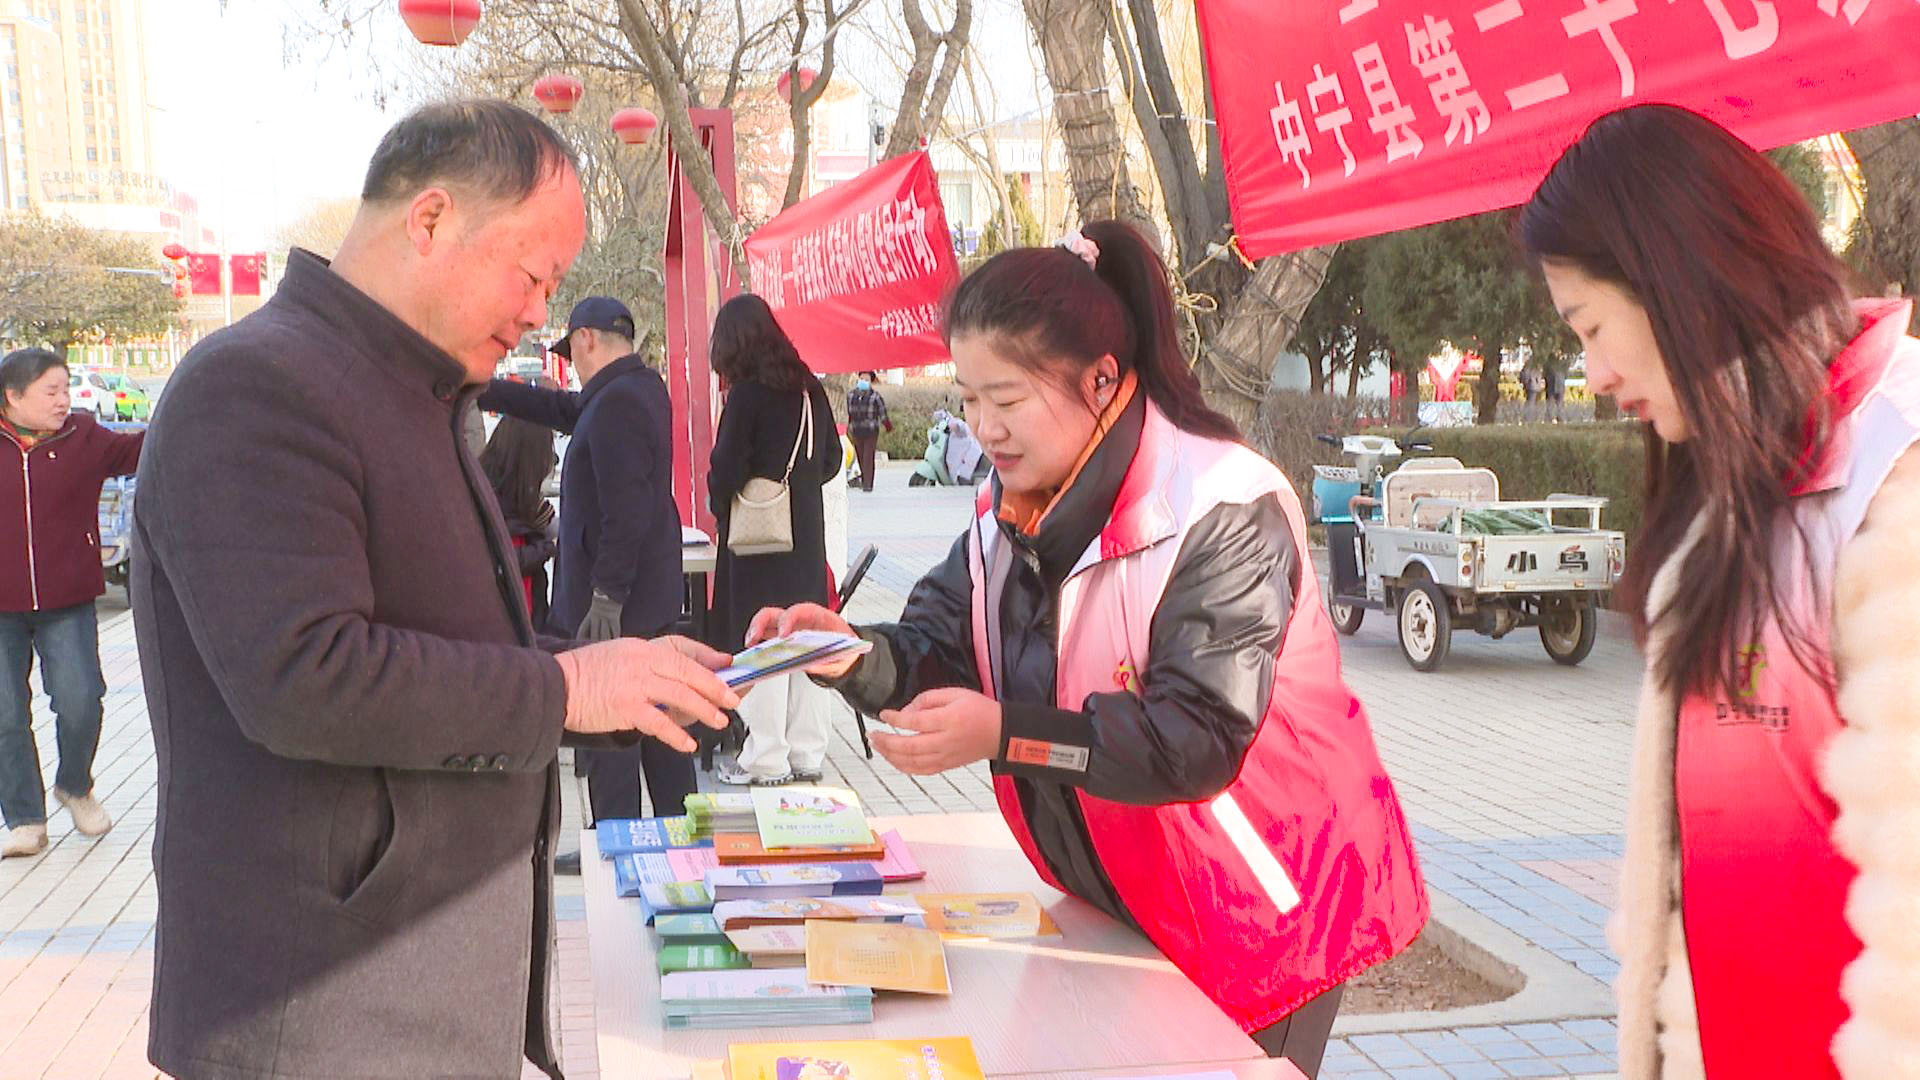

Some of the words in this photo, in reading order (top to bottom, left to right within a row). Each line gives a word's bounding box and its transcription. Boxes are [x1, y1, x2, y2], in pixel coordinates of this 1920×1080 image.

[1270, 0, 1871, 189] 中宁县第二十七
